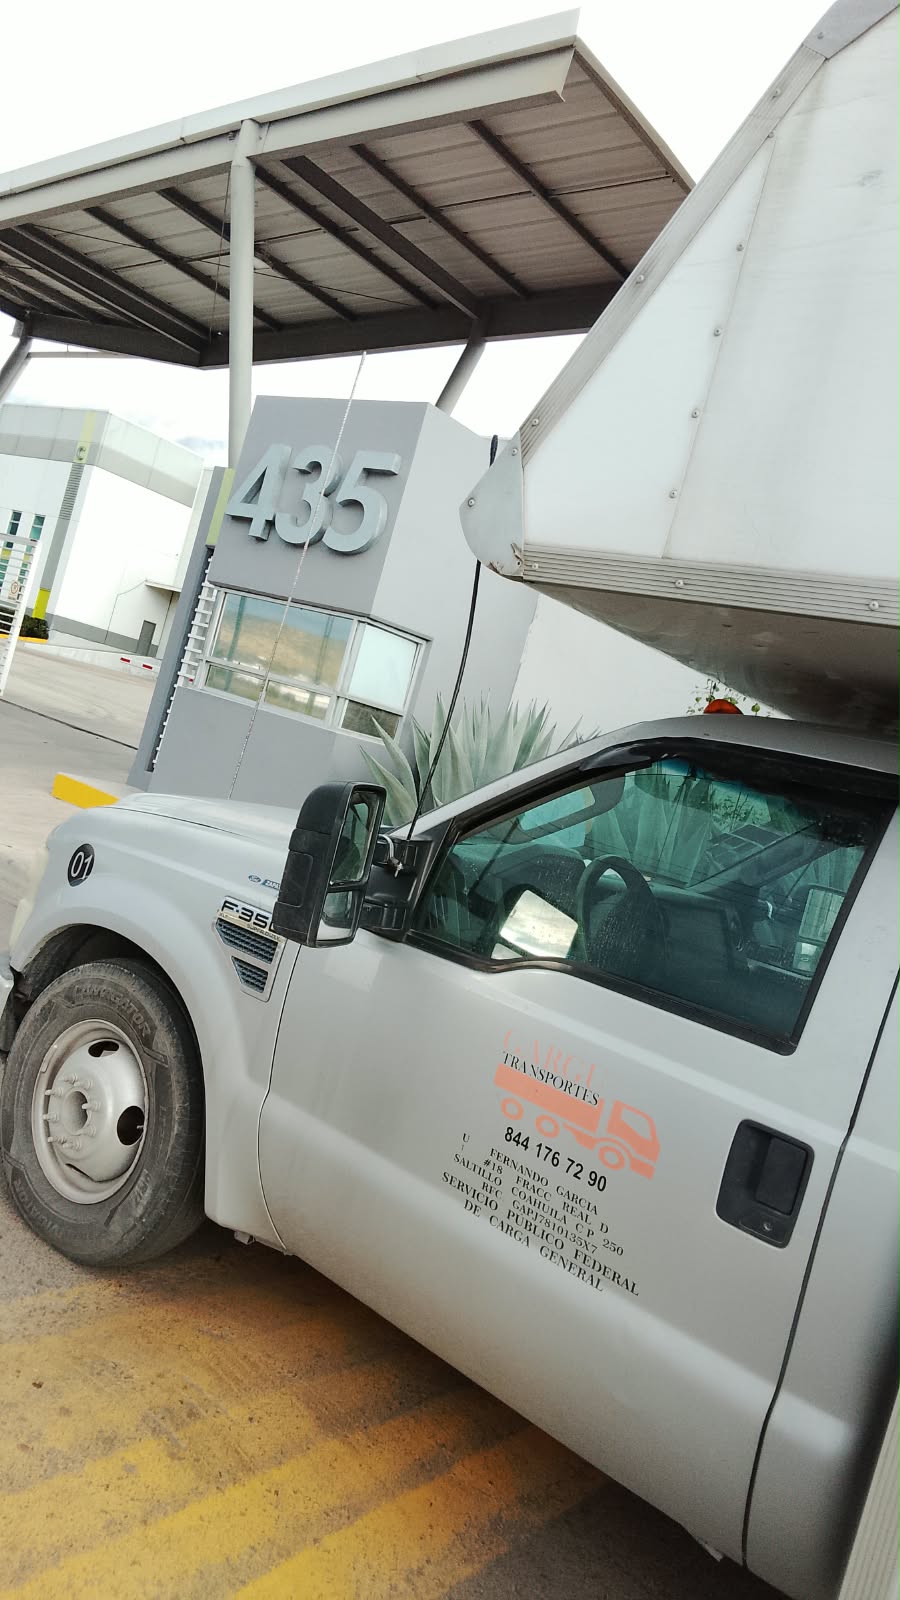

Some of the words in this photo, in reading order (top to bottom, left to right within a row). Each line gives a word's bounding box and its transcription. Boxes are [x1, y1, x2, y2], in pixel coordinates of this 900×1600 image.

[225, 443, 401, 554] 435
[71, 851, 93, 880] 01
[502, 1050, 600, 1106] TRANSPORTES
[483, 1159, 503, 1175] #18
[515, 1175, 552, 1202] FRACC
[562, 1201, 592, 1225] REAL
[489, 1147, 549, 1187] FERNANDO
[556, 1185, 598, 1216] GARCIA
[504, 1126, 530, 1151] 844
[536, 1143, 560, 1167] 176
[565, 1157, 584, 1180] 72
[587, 1170, 607, 1192] 90
[442, 1171, 498, 1211] SERVICIO
[574, 1249, 640, 1297] FEDERAL
[453, 1153, 502, 1187] SALTILLO
[511, 1186, 567, 1225] COAHUILA
[602, 1238, 624, 1256] 250
[481, 1181, 503, 1199] RFC
[512, 1199, 598, 1254] GAPJ7810135X7
[463, 1199, 482, 1218] DE
[489, 1215, 530, 1248] CARGA
[539, 1245, 603, 1292] GENERAL
